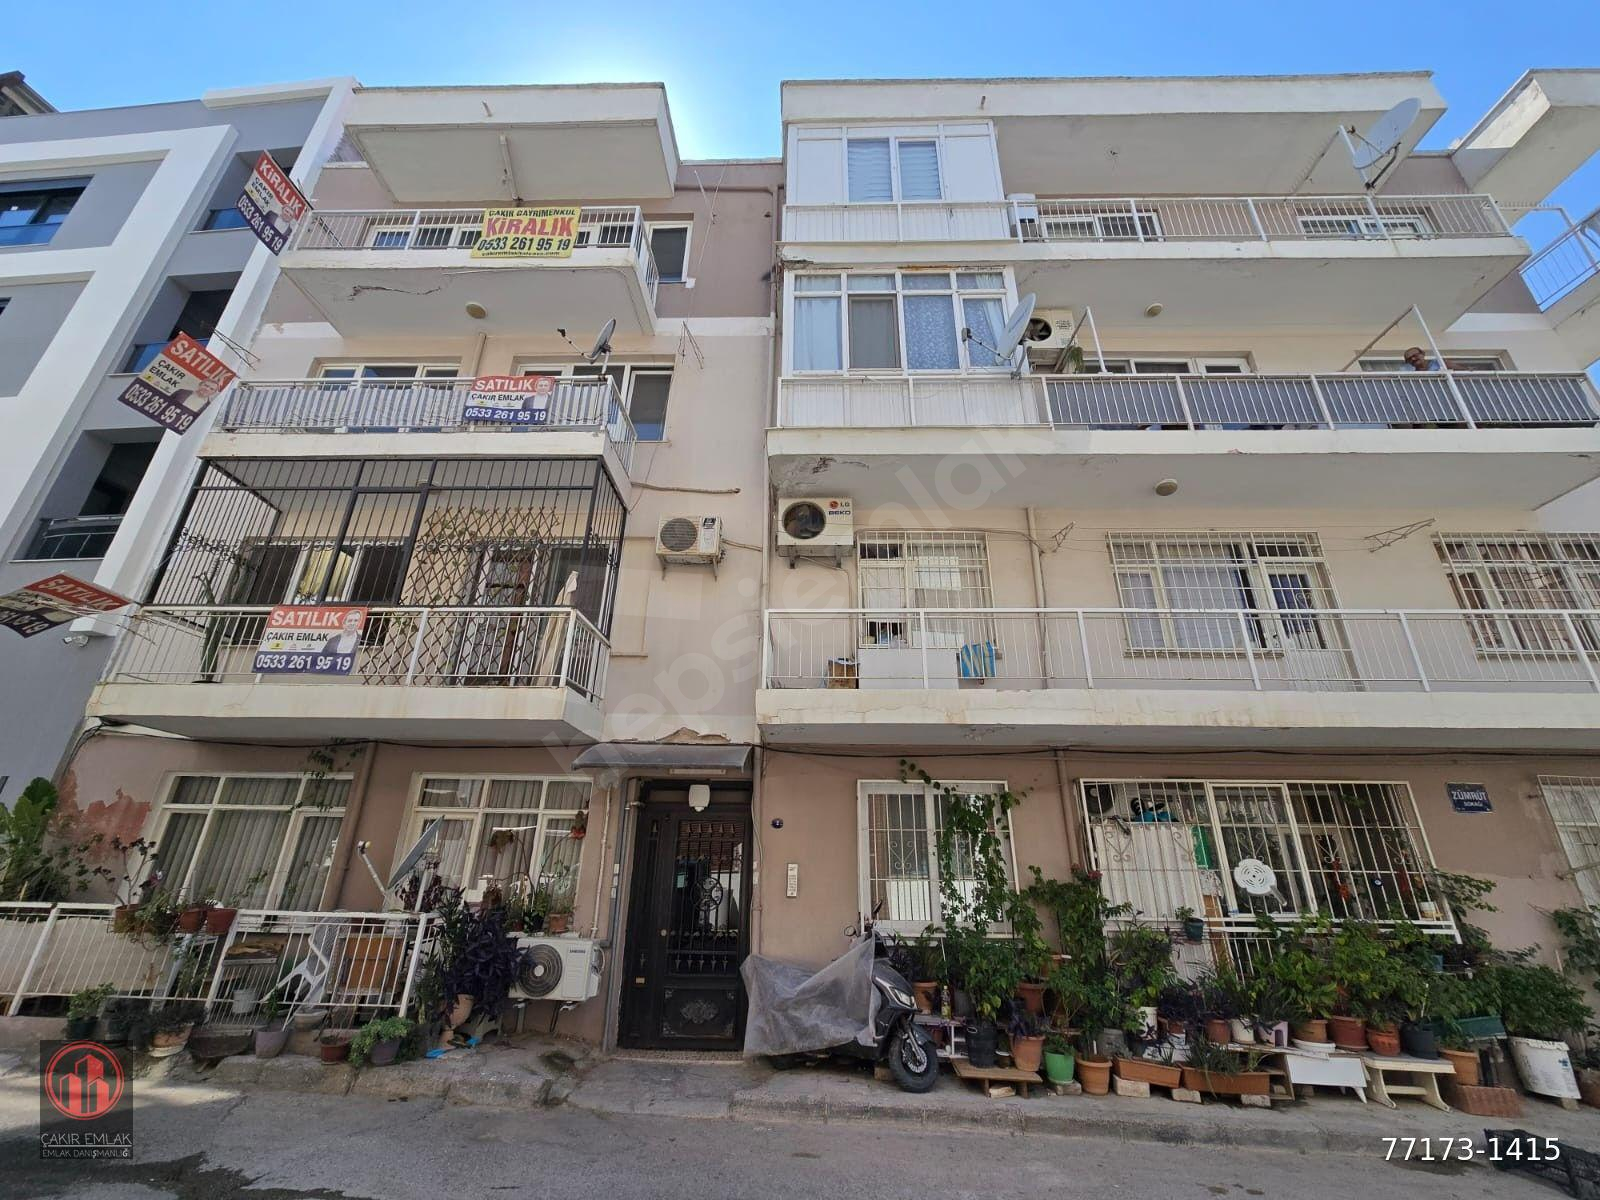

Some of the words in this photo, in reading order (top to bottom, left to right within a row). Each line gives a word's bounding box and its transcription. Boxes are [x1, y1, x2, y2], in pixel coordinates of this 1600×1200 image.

[238, 195, 255, 219] 0533
[250, 213, 264, 232] 261
[261, 226, 274, 242] 95
[271, 235, 283, 250] 19
[477, 236, 509, 251] 0533
[510, 237, 534, 251] 261
[535, 238, 553, 251] 95
[557, 238, 571, 251] 19
[170, 340, 232, 389] SATILIK
[149, 366, 180, 388] EMLAK
[475, 379, 534, 391] SATILIK
[125, 384, 152, 406] 0533
[144, 395, 168, 415] 261
[161, 406, 181, 424] 95
[174, 415, 193, 430] 19
[465, 408, 492, 418] 0533
[494, 411, 514, 420] 261
[517, 411, 530, 421] 95
[534, 411, 546, 421] 19
[271, 610, 343, 627] SATILIK
[266, 631, 295, 642] ÇAKIR
[296, 632, 330, 642] EMLAK
[256, 654, 287, 669] 0533
[288, 655, 313, 669] 261
[316, 656, 333, 670] 95
[335, 656, 351, 670] 19
